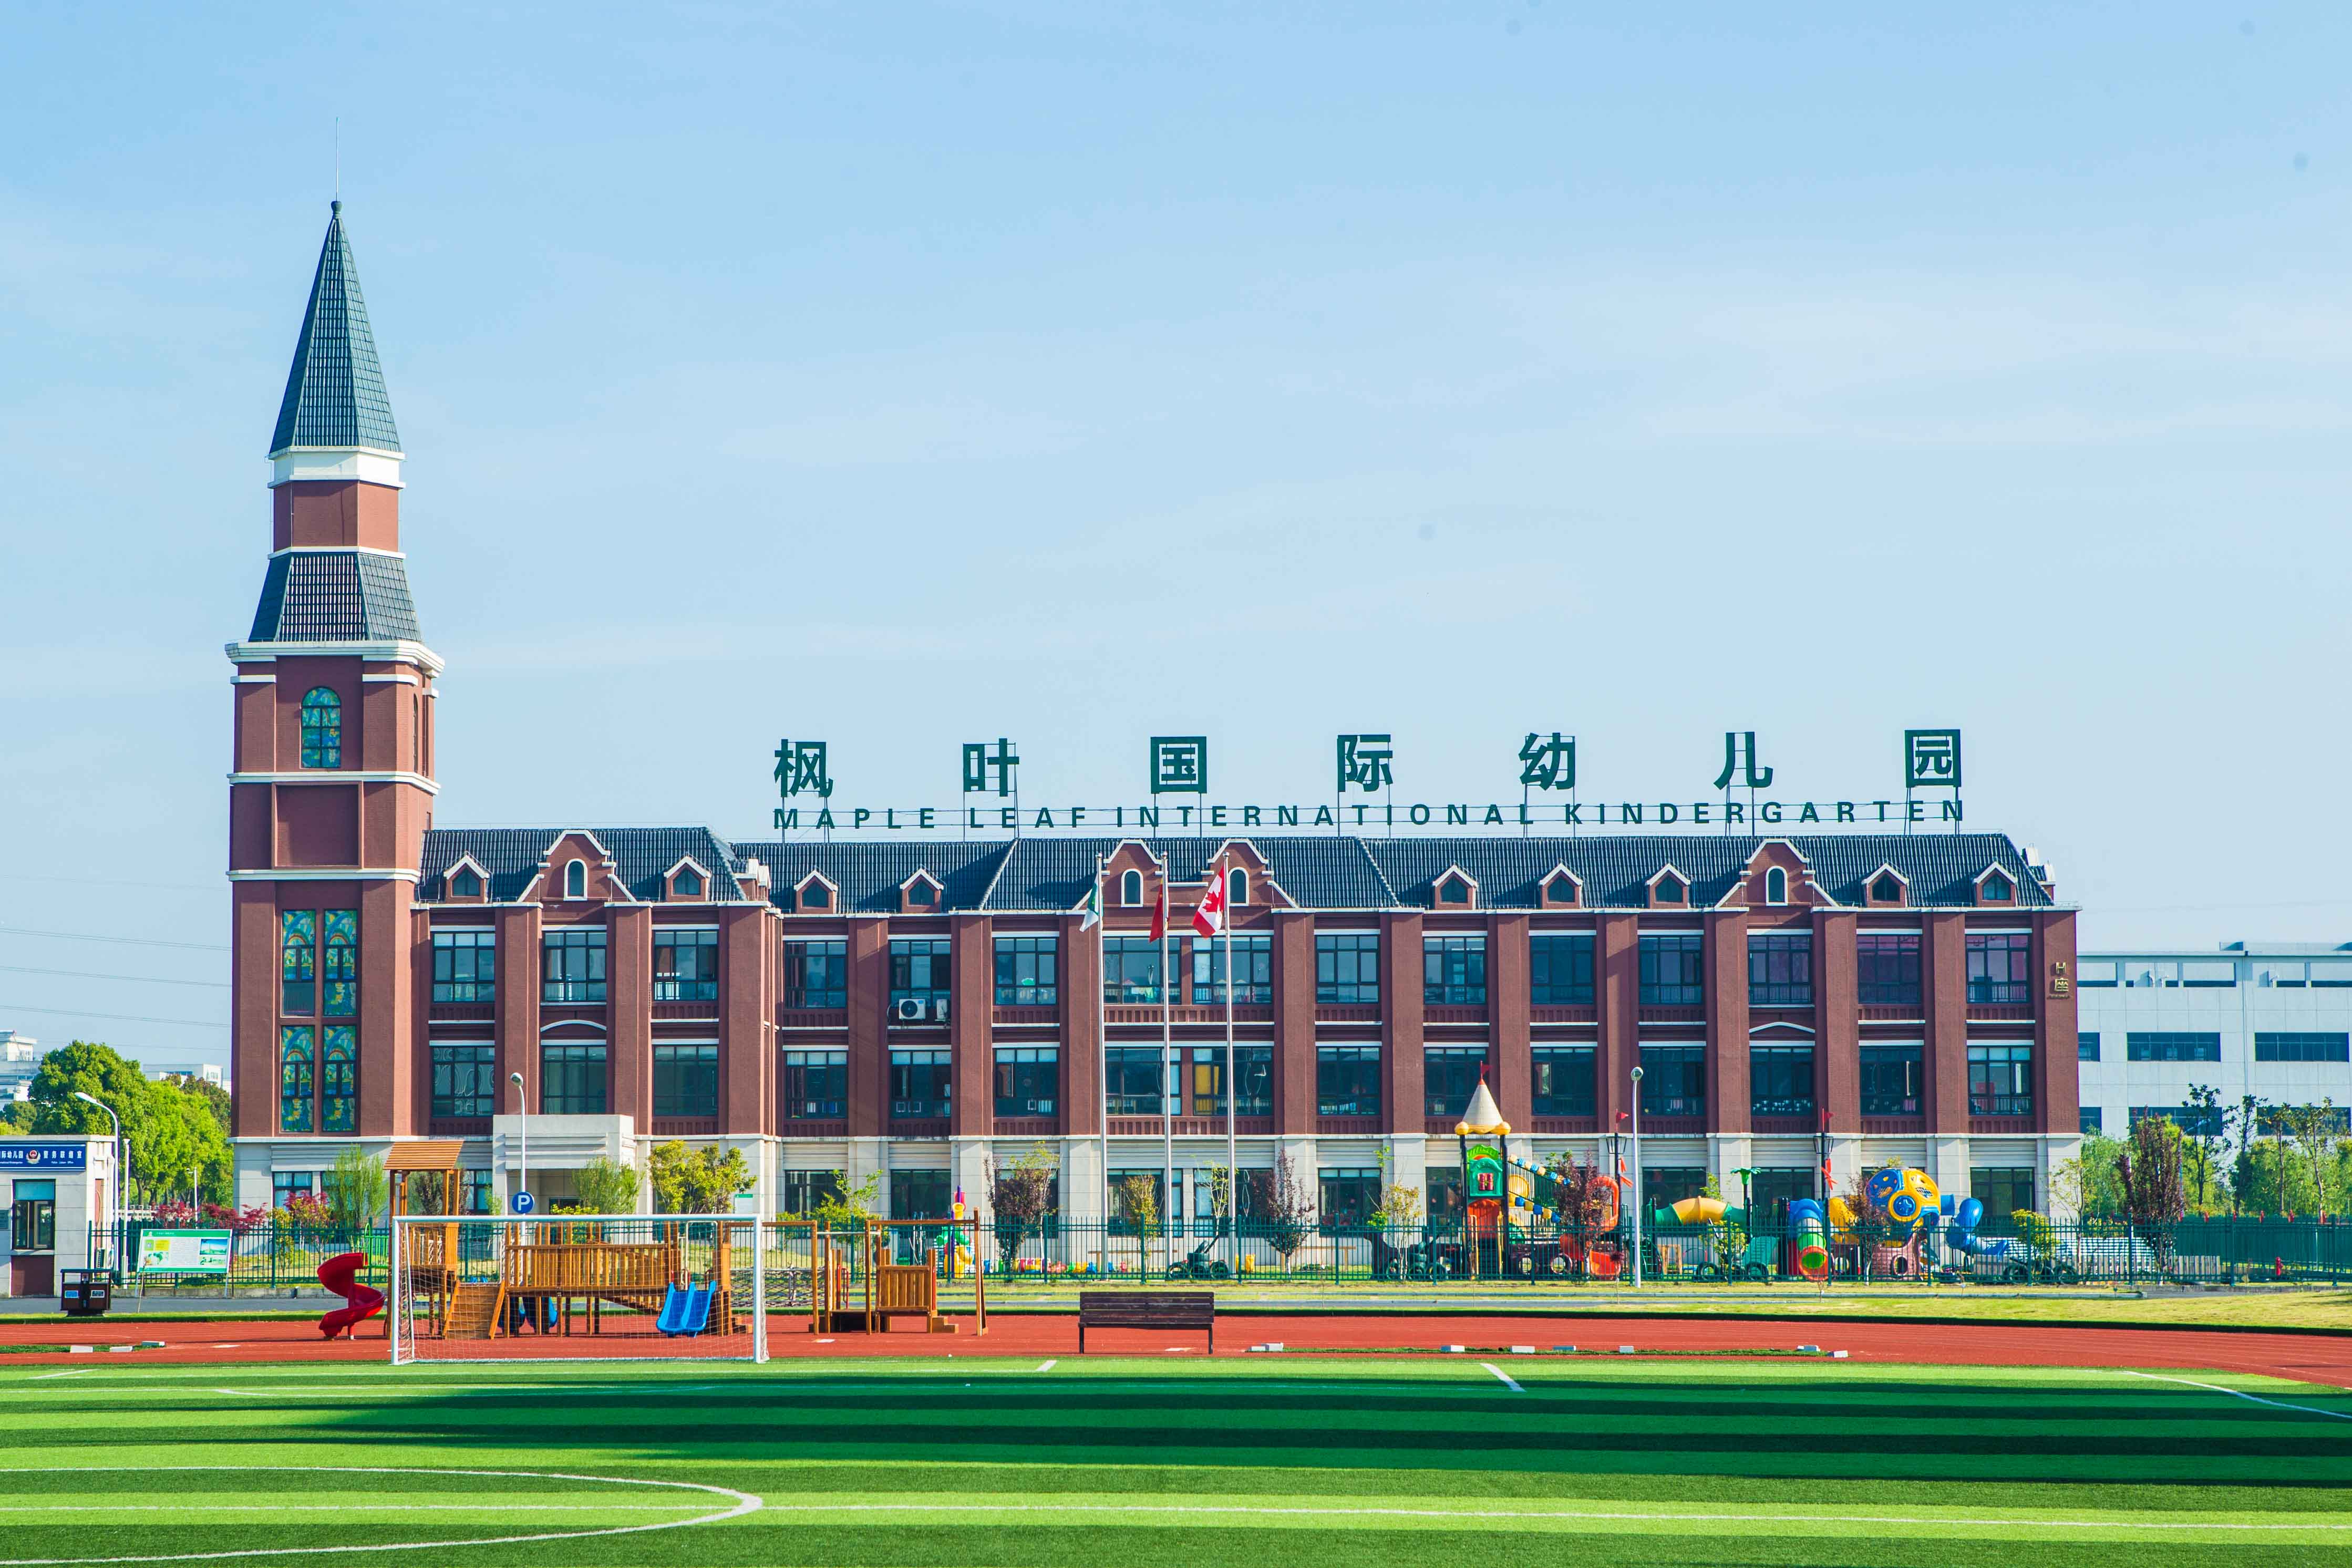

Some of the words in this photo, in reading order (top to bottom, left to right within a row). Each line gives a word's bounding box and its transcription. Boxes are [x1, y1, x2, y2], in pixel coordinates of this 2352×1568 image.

[774, 729, 1962, 798] 枫叶国际幼儿园
[774, 808, 935, 829] MAPLE
[969, 807, 1086, 828] LEAF
[1117, 804, 1534, 827] INTERNATIONAL
[1565, 800, 1963, 824] KINDERGARTEN
[518, 1195, 530, 1211] P
